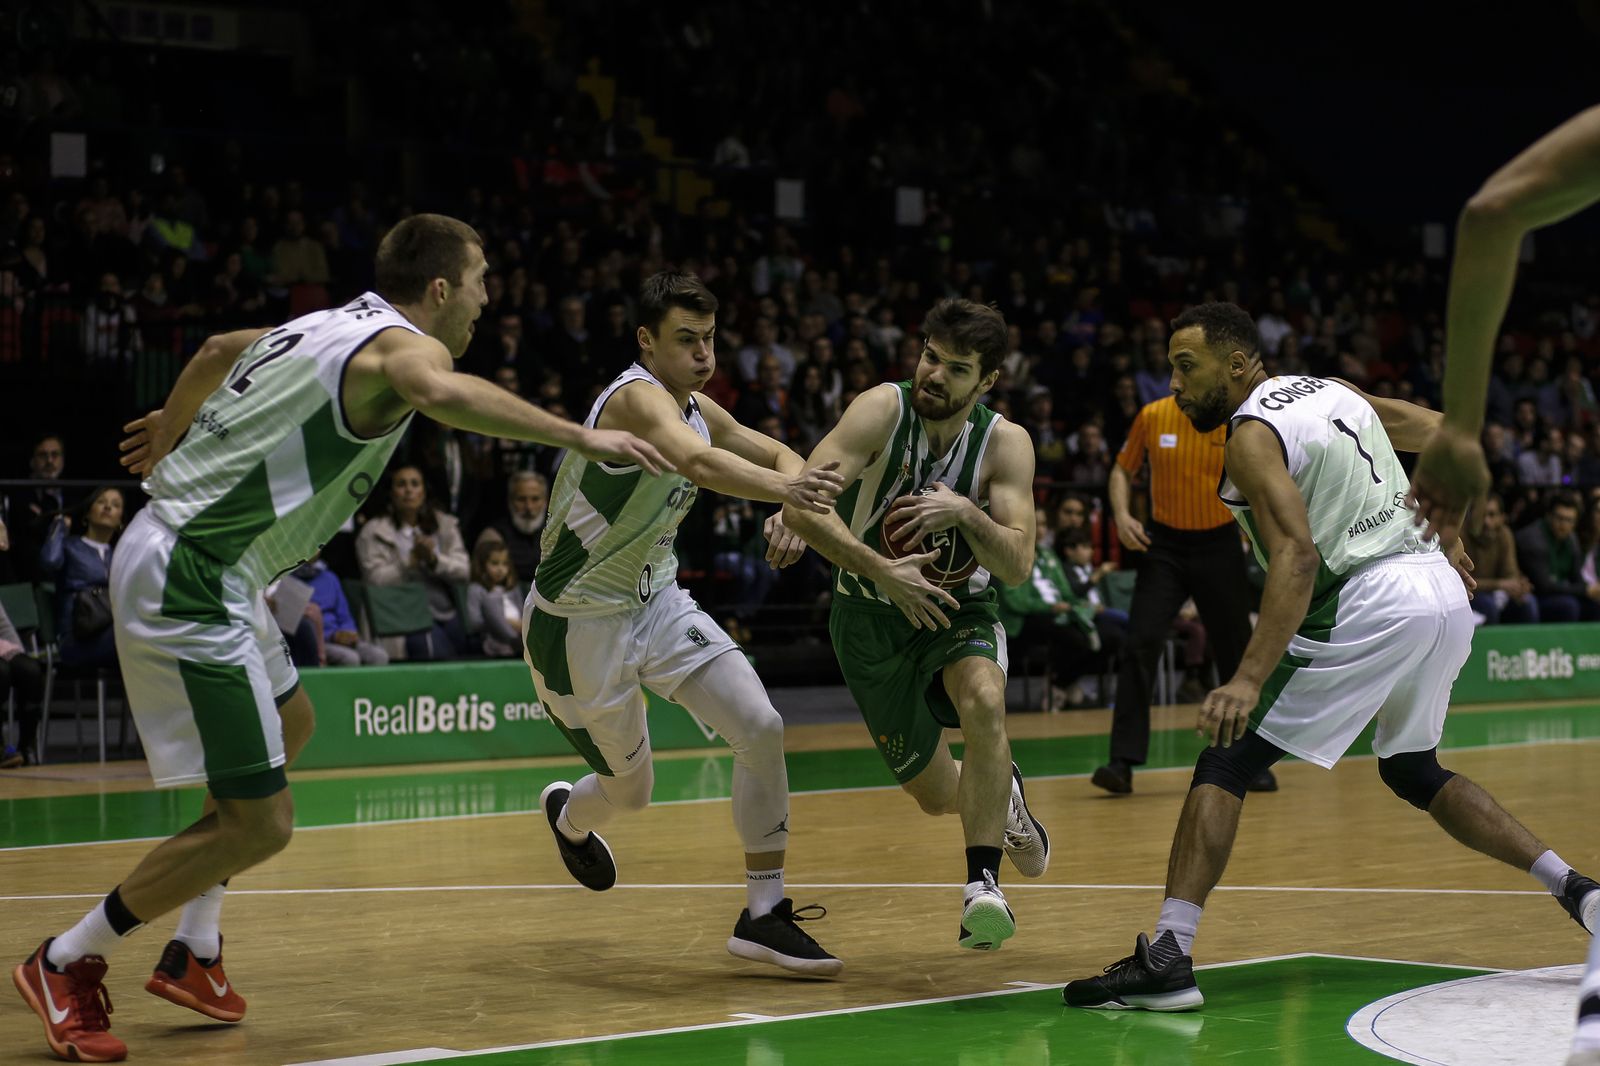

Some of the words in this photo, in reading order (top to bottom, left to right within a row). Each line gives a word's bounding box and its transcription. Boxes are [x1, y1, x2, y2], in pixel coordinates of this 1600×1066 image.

[1259, 376, 1330, 412] CONGE
[1332, 418, 1383, 485] 1
[638, 563, 652, 605] 0
[353, 693, 498, 738] RealBetis
